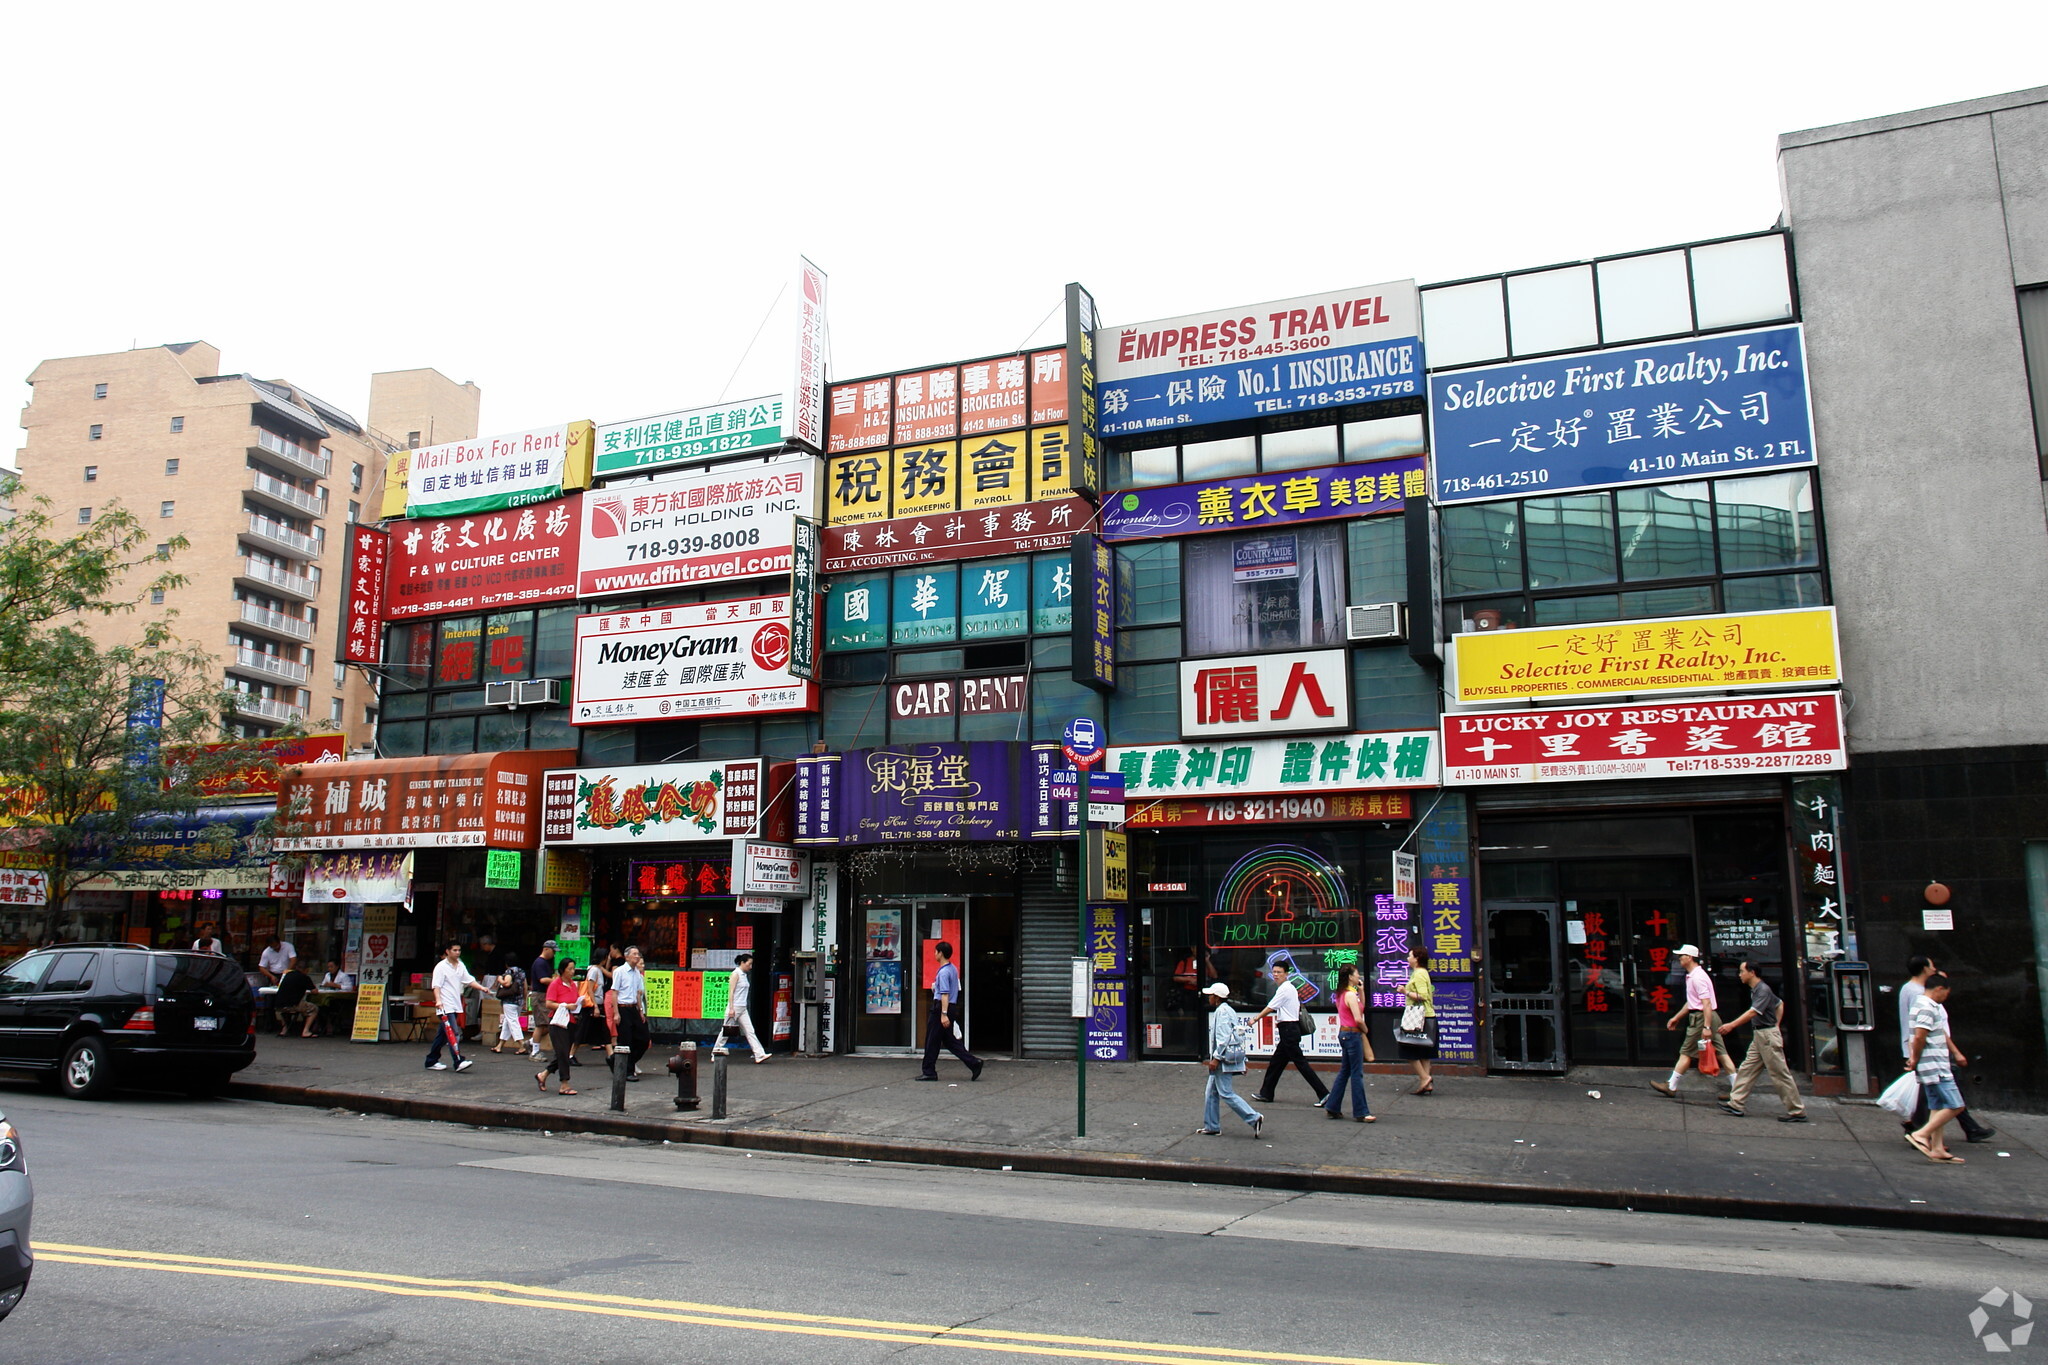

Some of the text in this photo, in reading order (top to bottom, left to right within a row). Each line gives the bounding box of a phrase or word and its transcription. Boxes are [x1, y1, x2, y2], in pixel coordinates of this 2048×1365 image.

[1118, 296, 1390, 363] EMPRESS TRAVEL
[1178, 335, 1330, 368] TEL: 718-445-3600
[831, 353, 1062, 416] 吉祥保險事務所
[1238, 346, 1413, 397] No.1 INSURANCE
[1444, 344, 1789, 412] Selective First Realty, Inc.
[895, 399, 955, 424] INSURANCE
[962, 389, 1025, 413] BROKERAGE
[1102, 374, 1227, 415] 第一保險
[1254, 398, 1292, 413] TEL:
[1297, 380, 1414, 408] 718-353-7578
[963, 415, 1025, 432] 41-12 Main St.
[1033, 409, 1064, 423] 2nd Floor
[1102, 412, 1193, 434] 41-10A Main St.
[1468, 391, 1768, 454] 一定好 置業公司
[830, 434, 887, 452] 718-888-1689
[897, 424, 954, 441] 718 888-9313
[417, 431, 561, 470] Mail Box For Rent
[634, 433, 752, 465] 718-939-1822
[1629, 440, 1806, 473] 41-10 Main St. 2 Fl.
[422, 458, 549, 493] 固定地址信箱出租
[1442, 469, 1549, 494] 718-461-2510
[631, 471, 804, 517] 東方紅國際旅游公司
[898, 502, 951, 515] BOOKKEEPING
[974, 494, 1013, 505] PAYROLL
[1197, 469, 1426, 526] 薰衣草 美容美體
[630, 498, 801, 533] DFH HOLDING INC.
[833, 511, 883, 523] INCOME TAX
[843, 503, 1073, 552] 陳林會計事務所
[627, 527, 760, 561] 718-939-8008
[409, 546, 560, 577] F & W CULTURE CENTER
[594, 553, 792, 591] www.dfhtravel.com
[372, 569, 381, 615] CULTURE
[391, 596, 474, 616] Tel:718-359-4421
[481, 584, 576, 604] Fax:718-359-4470
[599, 600, 784, 631] 匯款中國 當天即取
[369, 619, 378, 659] CENTER
[444, 625, 509, 640] Internet Cafe
[1536, 623, 1744, 656] 一定好 置業公司
[597, 635, 739, 665] MoneyGram
[1499, 647, 1787, 681] Selective First Realty, Inc.
[679, 661, 747, 686] 國際匯款
[1463, 686, 1509, 697] BUY/SELL
[1511, 682, 1568, 693] PROPERTIES
[1577, 673, 1714, 690] COMMERCIAL/RESIDENTIAL
[1782, 664, 1831, 679] 投資自住
[896, 676, 1024, 716] CAR RENT
[1459, 701, 1819, 734] LUCKY JOY RESTAURANT
[1065, 746, 1103, 763] NO STANDING
[1465, 721, 1817, 761] 十里香菜館
[871, 754, 970, 794] 東海堂
[1065, 771, 1077, 784] A/B
[1455, 767, 1521, 780] 41-10 MAIN ST.
[1666, 753, 1832, 772] Tel:718-539-2287/2289
[1052, 787, 1071, 798] Q44
[1204, 797, 1325, 822] 718-321-1940
[1331, 795, 1403, 817] 服務最佳
[947, 813, 993, 828] Bakery
[996, 829, 1018, 838] 41-12
[755, 861, 789, 873] MoneyGram
[1153, 883, 1182, 891] 41-10A
[1223, 920, 1339, 942] HOUR PHOTO
[1431, 882, 1463, 957] 薰衣草
